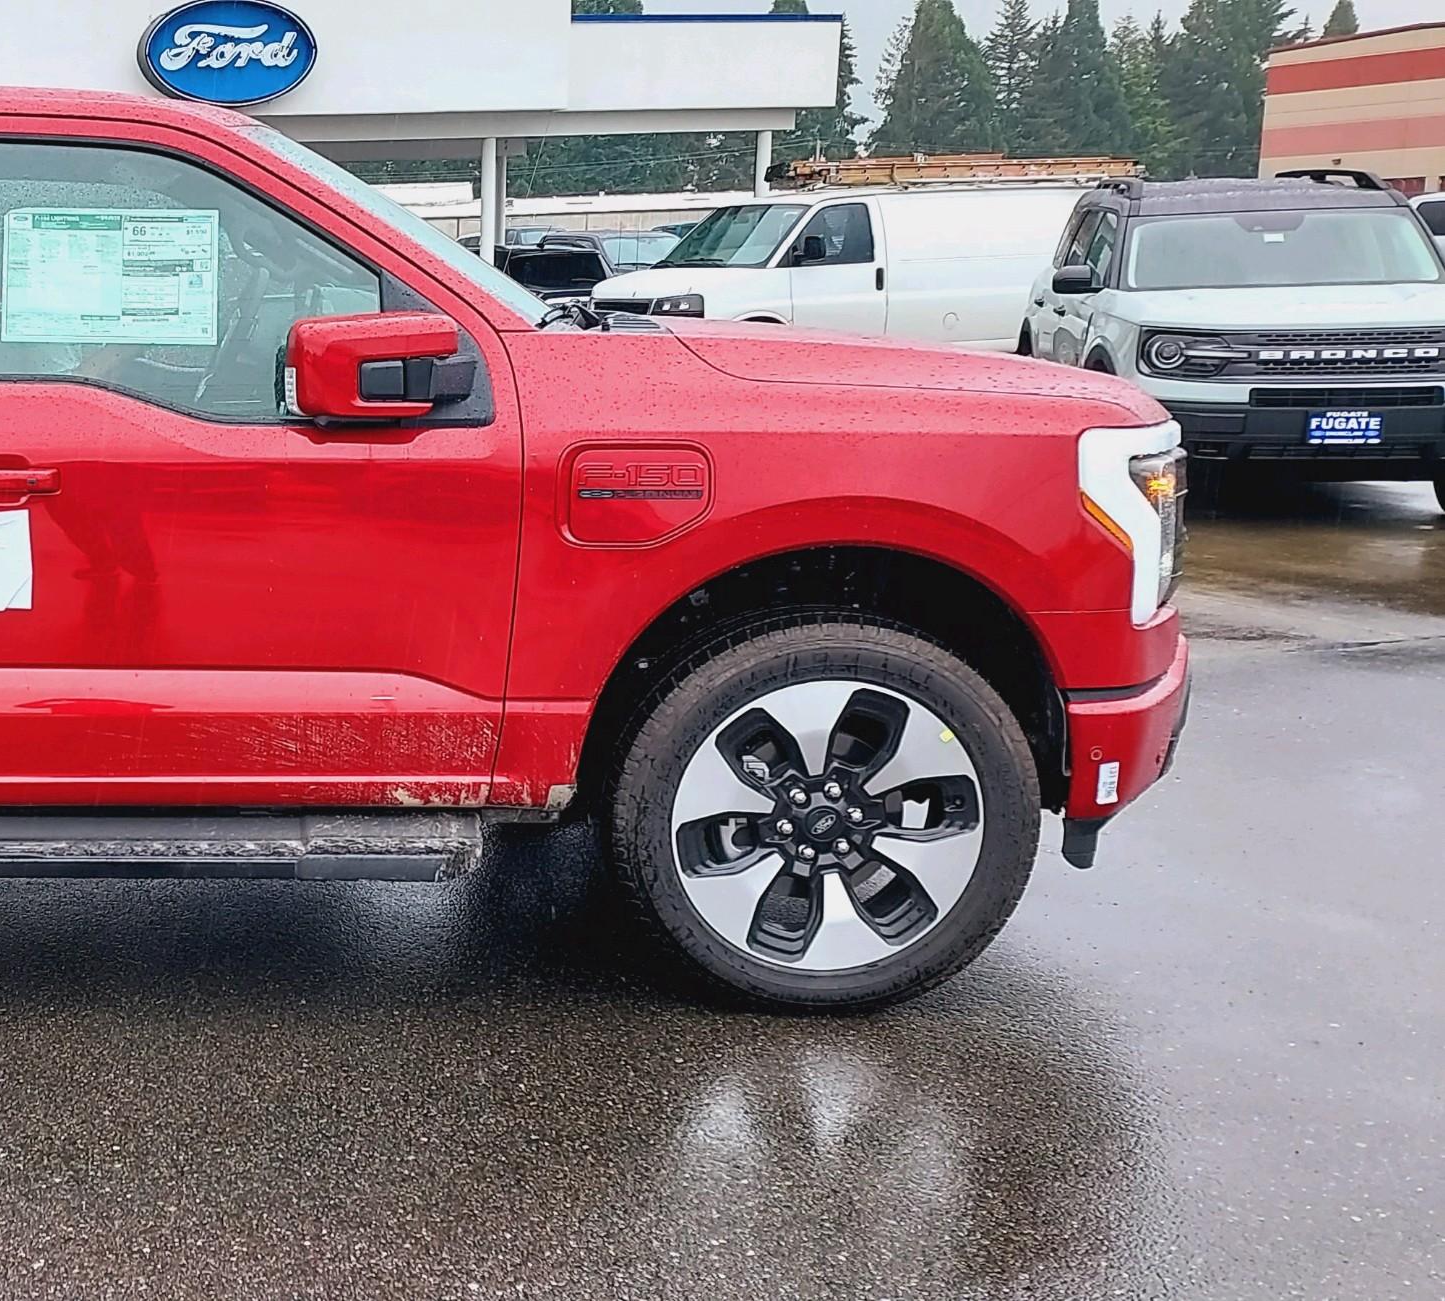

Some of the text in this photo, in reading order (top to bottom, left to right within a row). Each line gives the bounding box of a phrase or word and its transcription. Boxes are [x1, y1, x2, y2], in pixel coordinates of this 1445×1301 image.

[160, 24, 298, 70] Ford
[1258, 347, 1440, 360] BRONCO
[1310, 417, 1382, 429] FUGATE
[578, 463, 704, 486] F-150
